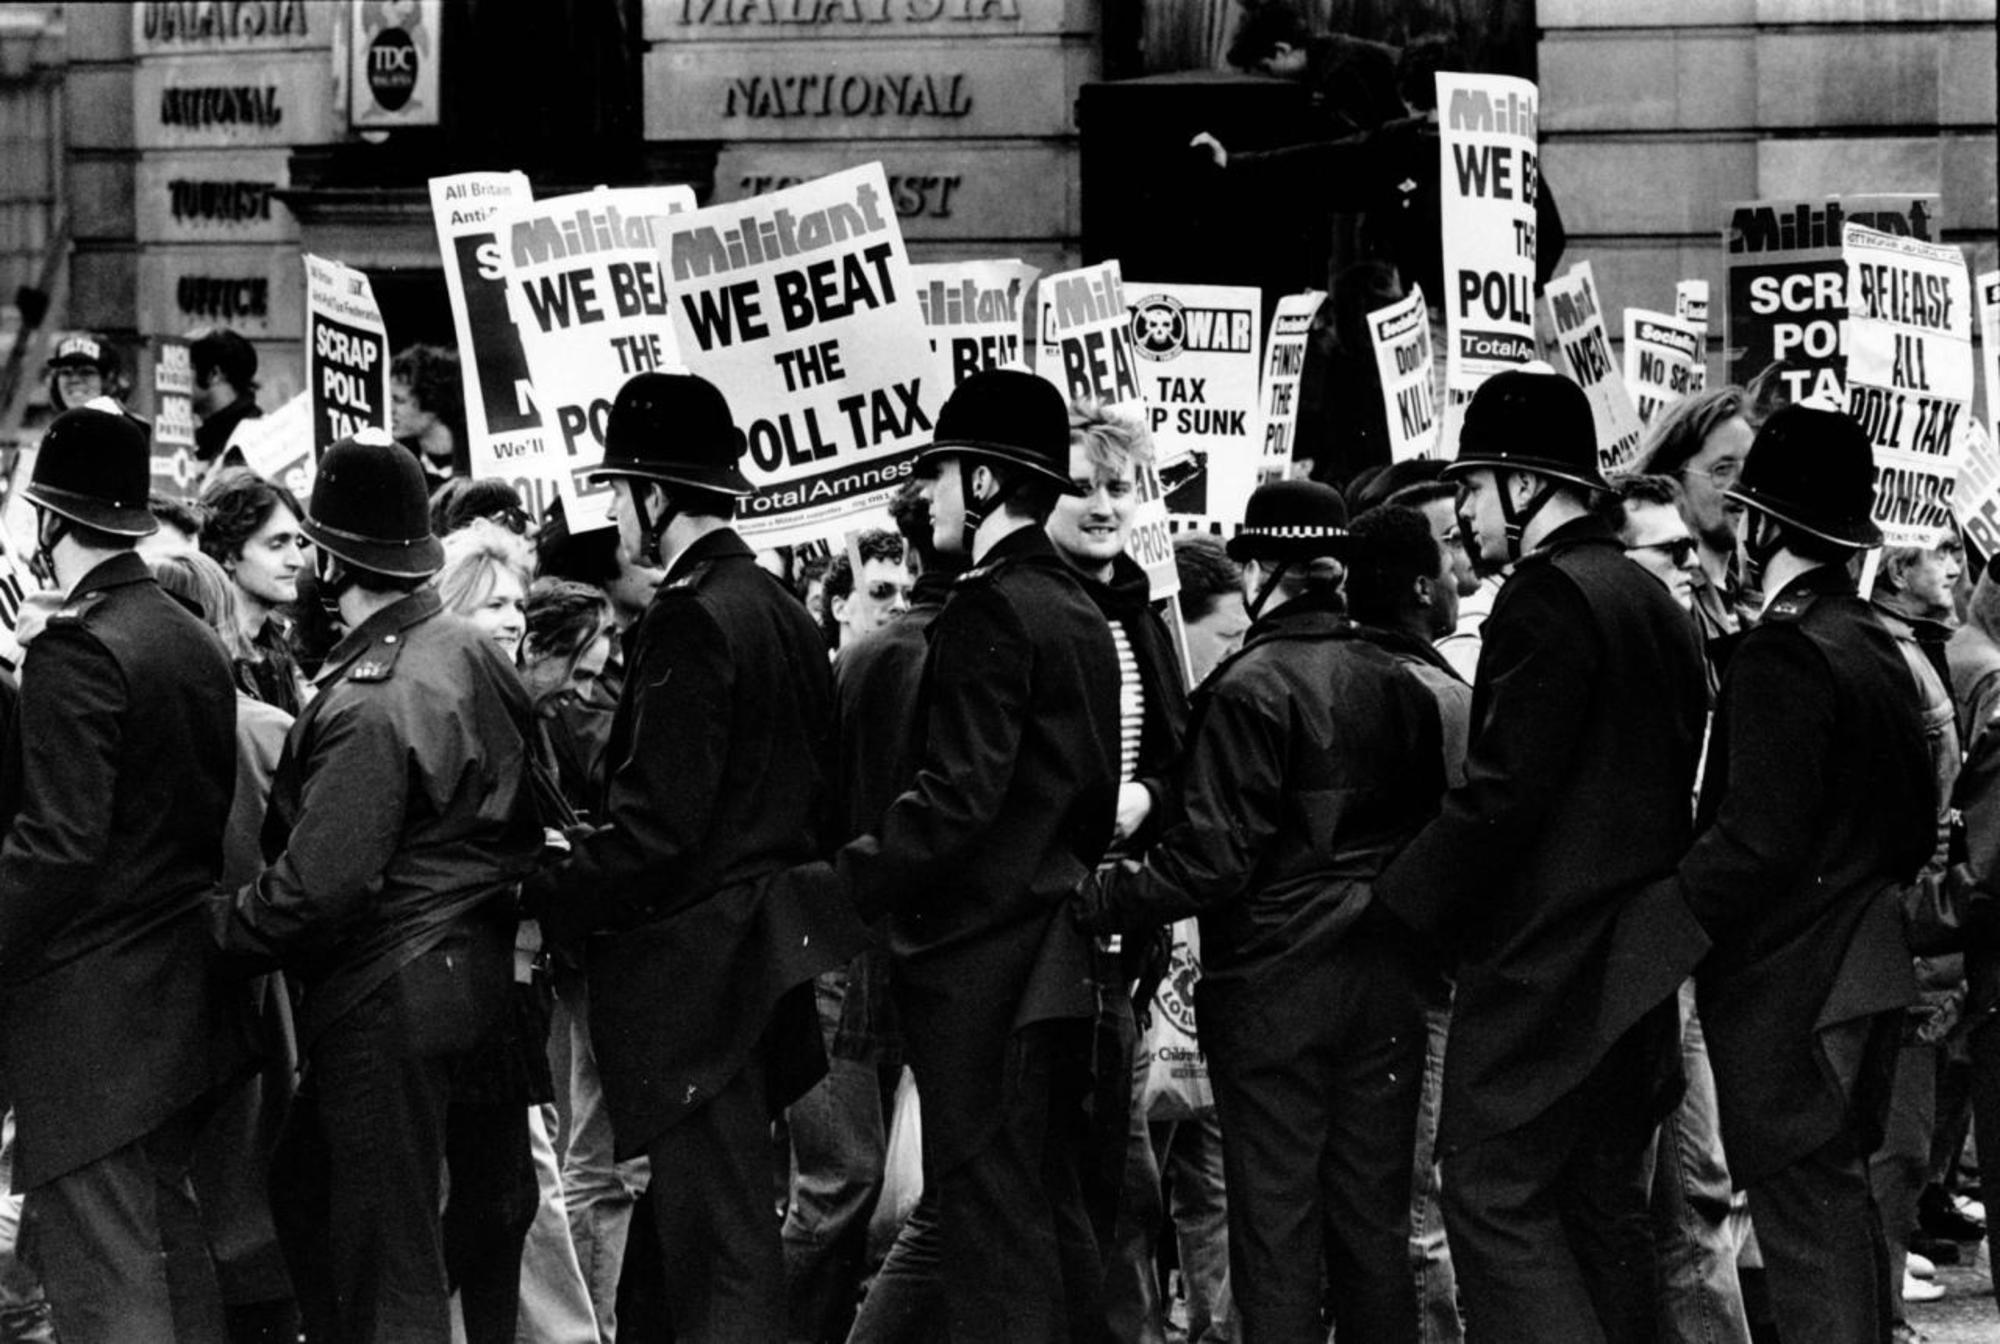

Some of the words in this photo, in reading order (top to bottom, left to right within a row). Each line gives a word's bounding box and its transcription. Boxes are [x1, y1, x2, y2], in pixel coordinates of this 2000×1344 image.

[372, 45, 414, 71] TDC
[724, 74, 972, 118] NATIONAL
[446, 183, 467, 201] All
[1452, 143, 1513, 200] WE
[671, 182, 887, 281] Militant
[522, 267, 605, 333] WE
[681, 279, 771, 352] WE
[774, 242, 897, 332] BEAT
[916, 277, 1021, 326] ilitant
[1459, 269, 1531, 326] POLL
[1750, 271, 1848, 314] SCR
[1859, 263, 1953, 330] RELEASE
[316, 323, 378, 372] SCRAP
[1185, 310, 1250, 351] WAR
[1462, 335, 1516, 357] Total
[610, 333, 664, 374] THE
[774, 339, 846, 392] THE
[1640, 350, 1665, 386] NO
[1892, 334, 1931, 391] ALL
[323, 366, 372, 413] POLL
[1157, 377, 1206, 404] TAX
[1270, 383, 1293, 416] THE
[838, 376, 934, 451] TAX
[1177, 408, 1246, 436] SUNK
[1911, 398, 1961, 457] TAX
[493, 438, 545, 459] We'll
[735, 484, 806, 513] Total
